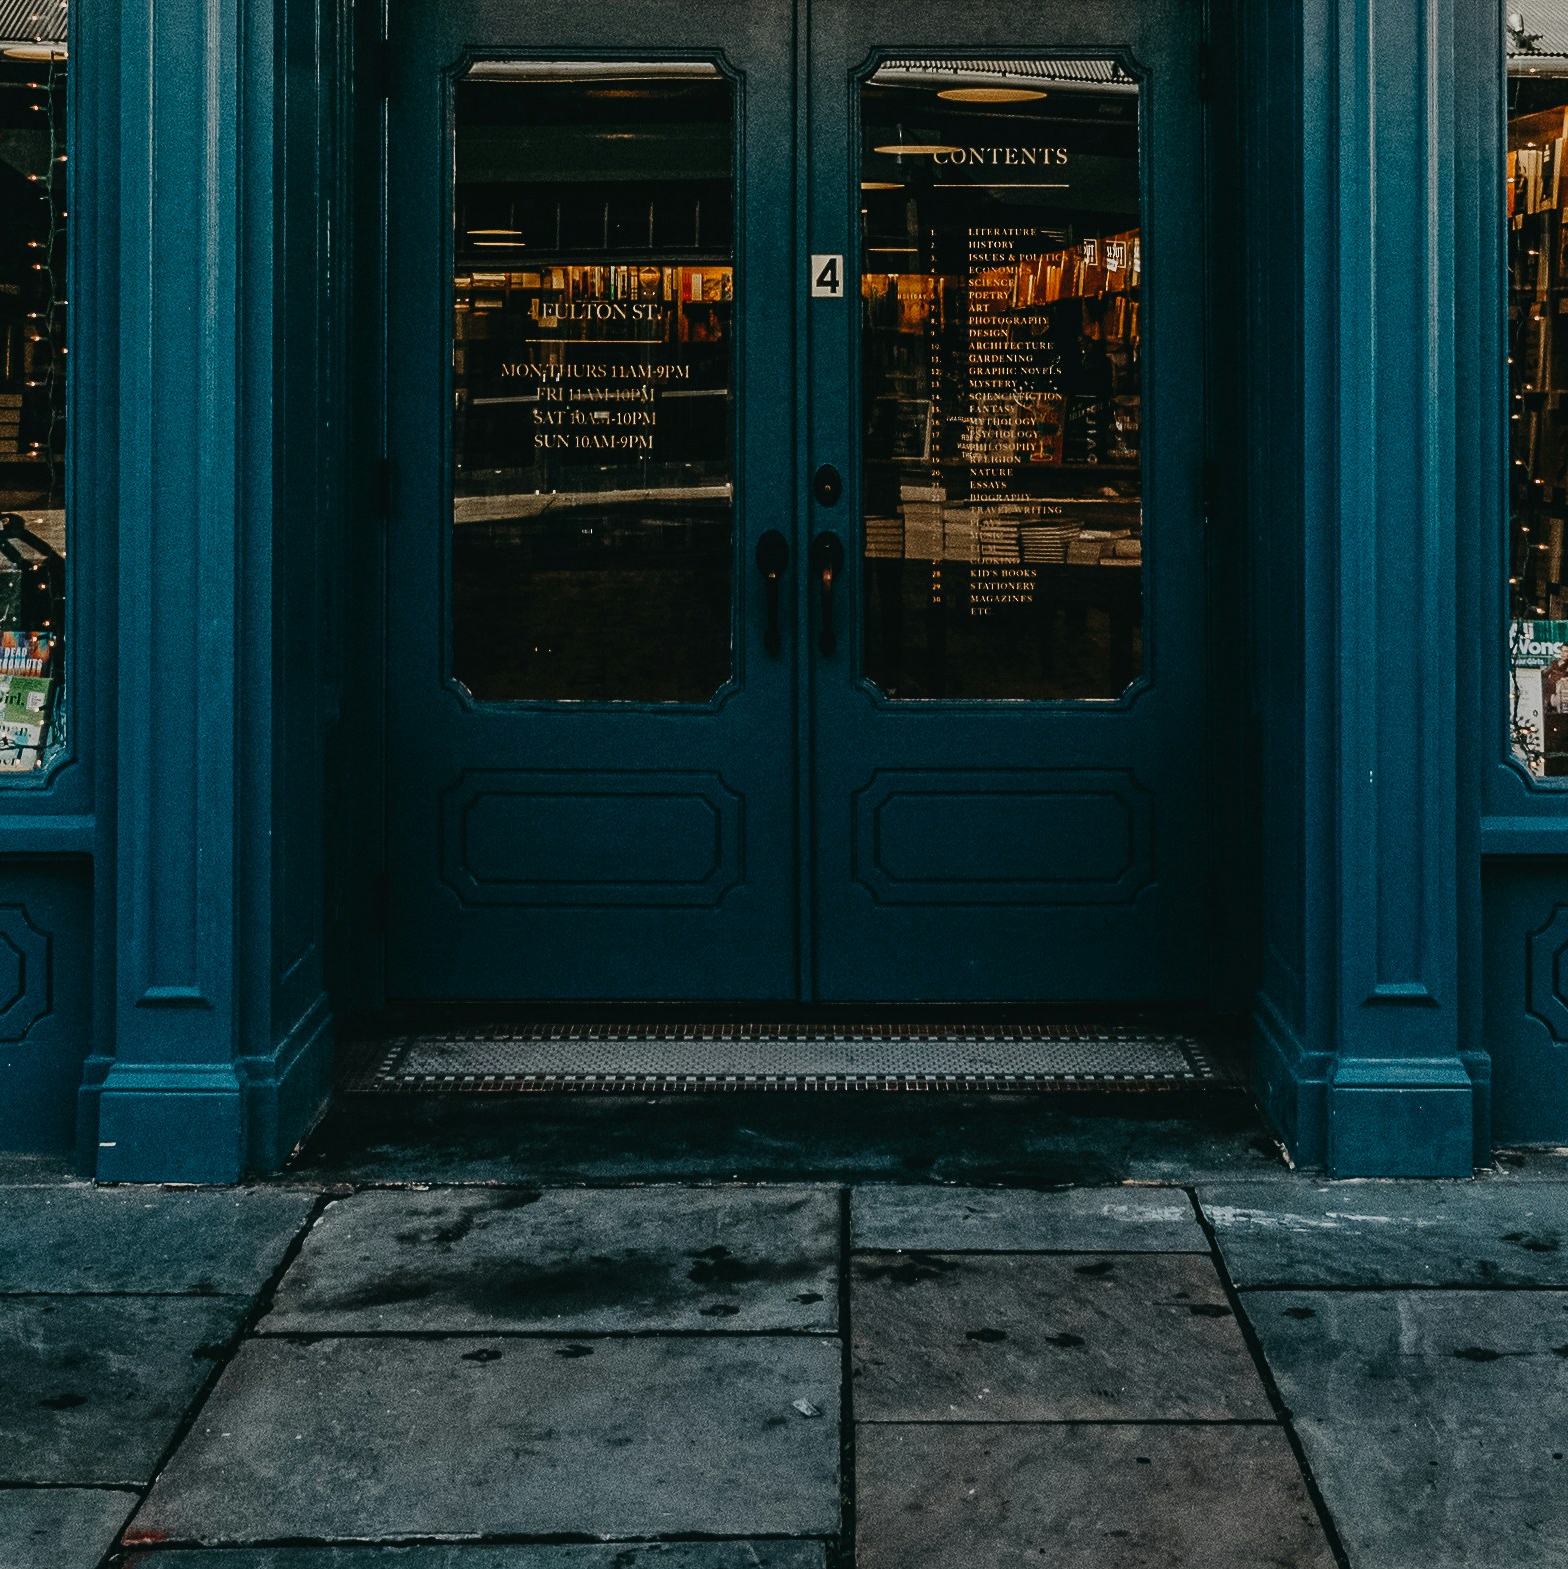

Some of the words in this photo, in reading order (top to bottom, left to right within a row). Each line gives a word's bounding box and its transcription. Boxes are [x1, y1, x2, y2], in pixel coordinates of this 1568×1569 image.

[933, 147, 1069, 165] CONTENTS
[968, 228, 1037, 236] LITERATURE
[968, 240, 1016, 249] HISTORY
[968, 253, 1006, 262] ISSUES
[1008, 253, 1016, 262] &
[816, 258, 840, 293] 4
[968, 278, 1016, 287] SCIENCE
[968, 291, 1011, 300] POETRY
[542, 303, 627, 321] FULTON
[968, 303, 991, 312] ART
[968, 316, 1049, 325] PHOTOGRAPHY
[968, 328, 1009, 337] DESIGN
[968, 341, 1054, 351] ARCHITECTURE
[968, 353, 1034, 363] GARDENING
[501, 363, 607, 378] MON-THURS
[611, 364, 690, 379] 11AM-9PM
[968, 367, 1017, 376] GRAPHIC
[1020, 367, 1063, 376] NOVELS
[968, 379, 1018, 388] MYSTERY
[536, 387, 563, 401] FRI
[969, 404, 1016, 414] FANTASY
[533, 410, 567, 425] SAT
[969, 417, 1037, 427] MYTHOLOGY
[969, 430, 1039, 439] PSYCHOLOGY
[534, 434, 570, 448] SUN
[575, 435, 653, 449] 10AM-9PM
[970, 442, 1037, 452] PHILOSOPHY
[970, 455, 1022, 464] RELIGION
[970, 468, 1014, 477] NATURE
[970, 480, 1007, 489] ESSAYS
[970, 493, 1031, 502] BIOGRAPHY
[1016, 505, 1063, 515] WRITING
[1001, 569, 1038, 578] BOOKS
[970, 581, 1036, 591] STATIONERY
[970, 595, 1034, 604] MAGAZINES
[3, 647, 28, 658] DEAD
